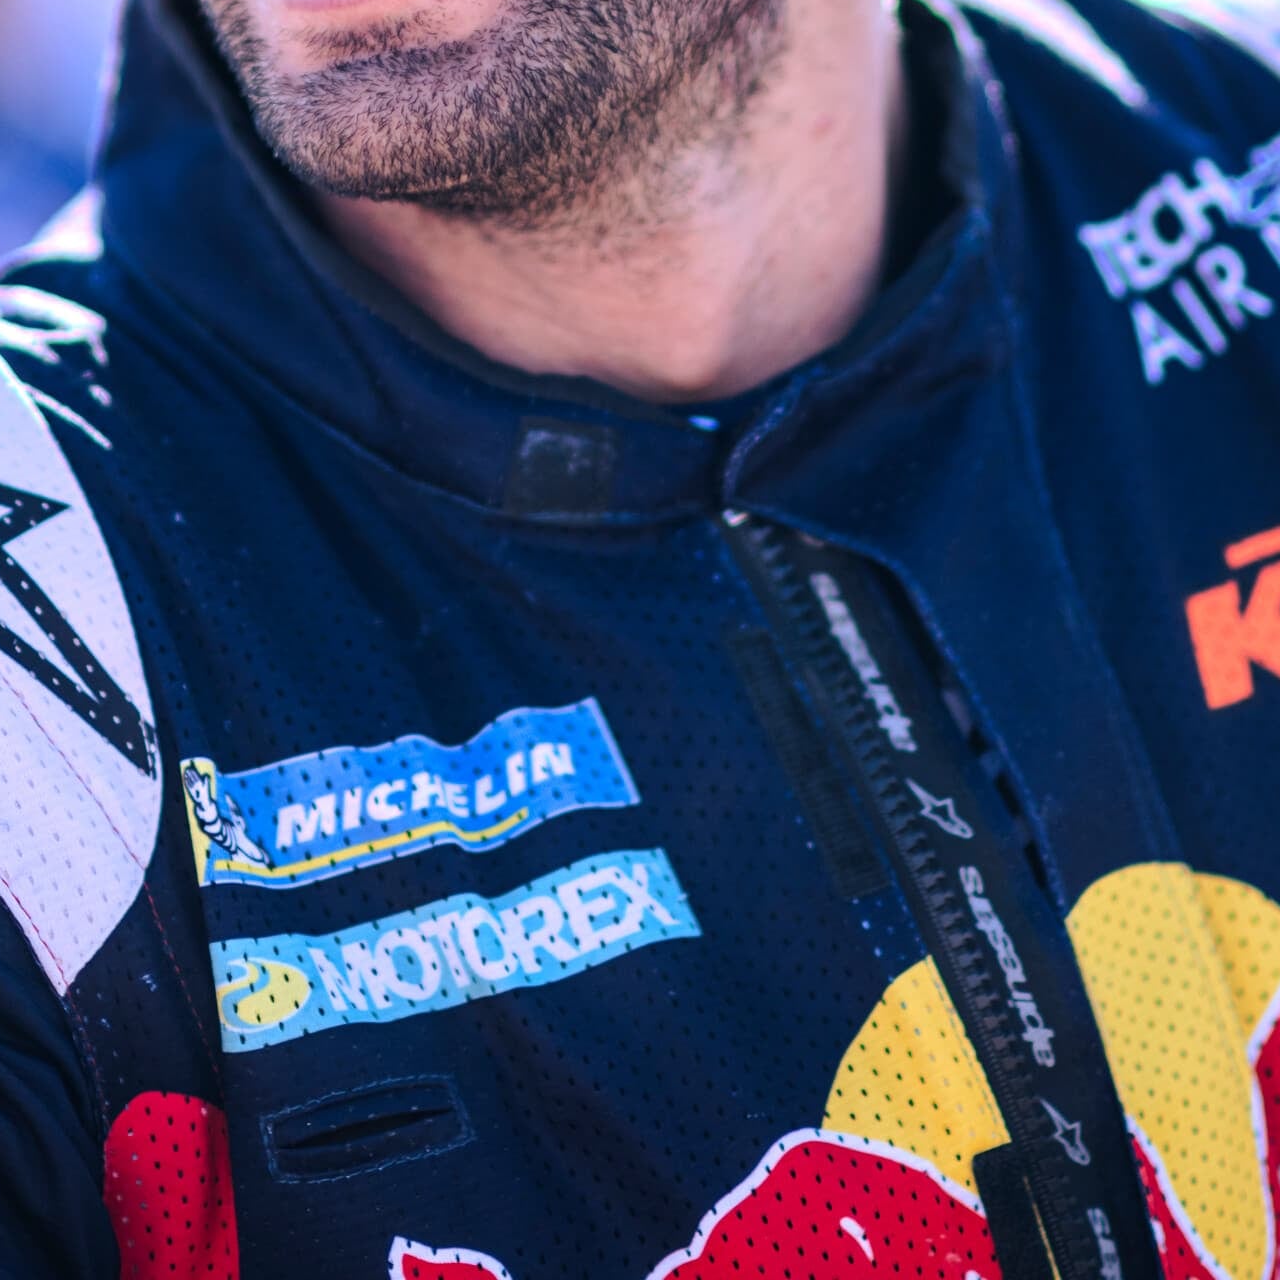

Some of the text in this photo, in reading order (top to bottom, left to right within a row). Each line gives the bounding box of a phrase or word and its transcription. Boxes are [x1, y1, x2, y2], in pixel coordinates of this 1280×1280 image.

[1130, 244, 1274, 385] AIR
[275, 743, 576, 849] MICHELIN
[310, 862, 681, 1012] MOTOREX
[958, 865, 1056, 1068] alpinestars
